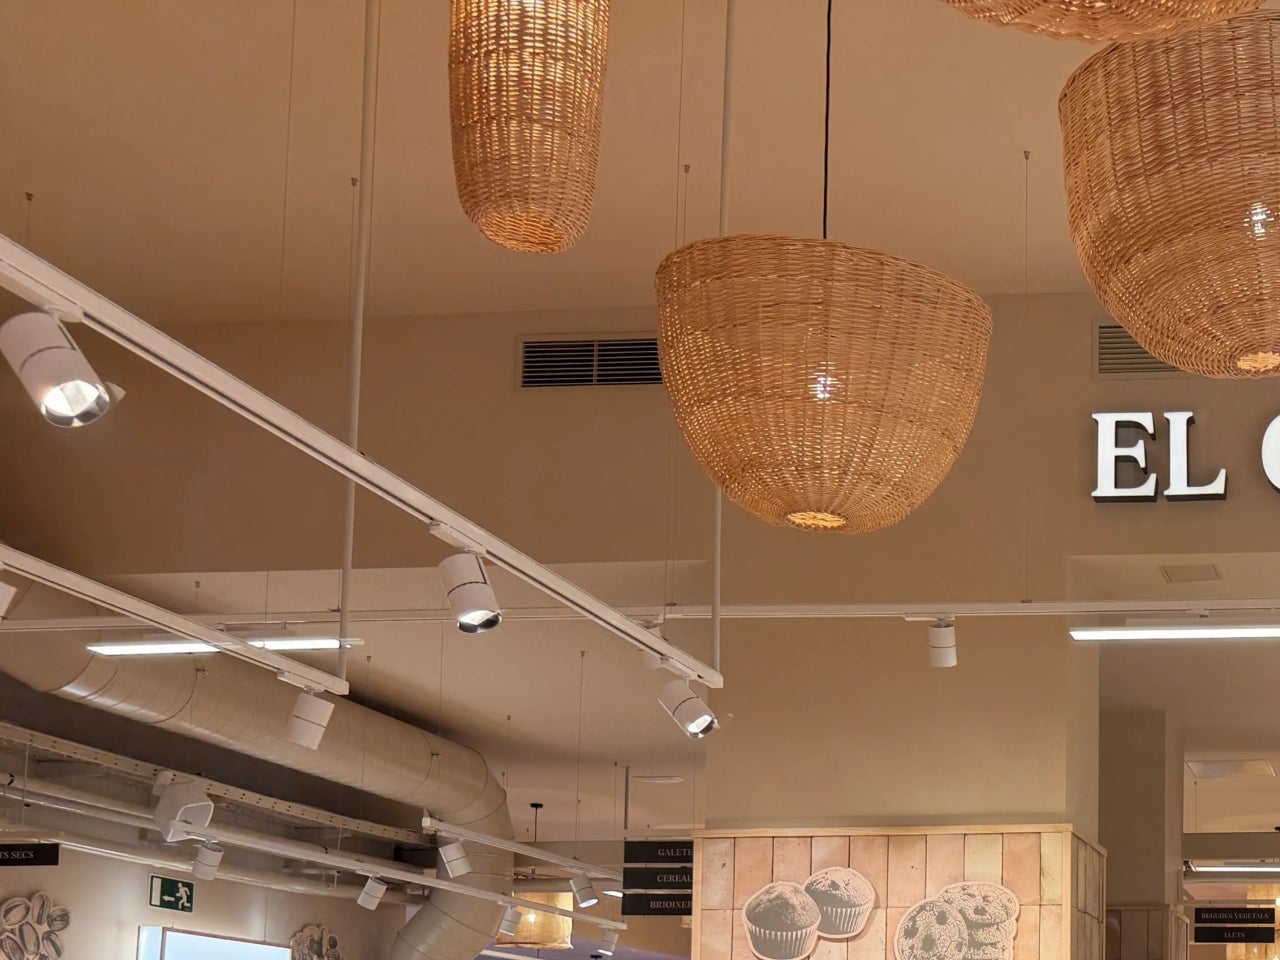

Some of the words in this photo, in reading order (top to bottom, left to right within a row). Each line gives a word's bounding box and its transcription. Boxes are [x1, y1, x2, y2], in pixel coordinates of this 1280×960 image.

[1091, 411, 1227, 498] EL
[11, 850, 34, 859] SECS
[1201, 912, 1233, 920] BEGUDES
[1234, 912, 1270, 920] VEGETALS
[1224, 931, 1246, 939] LLETS
